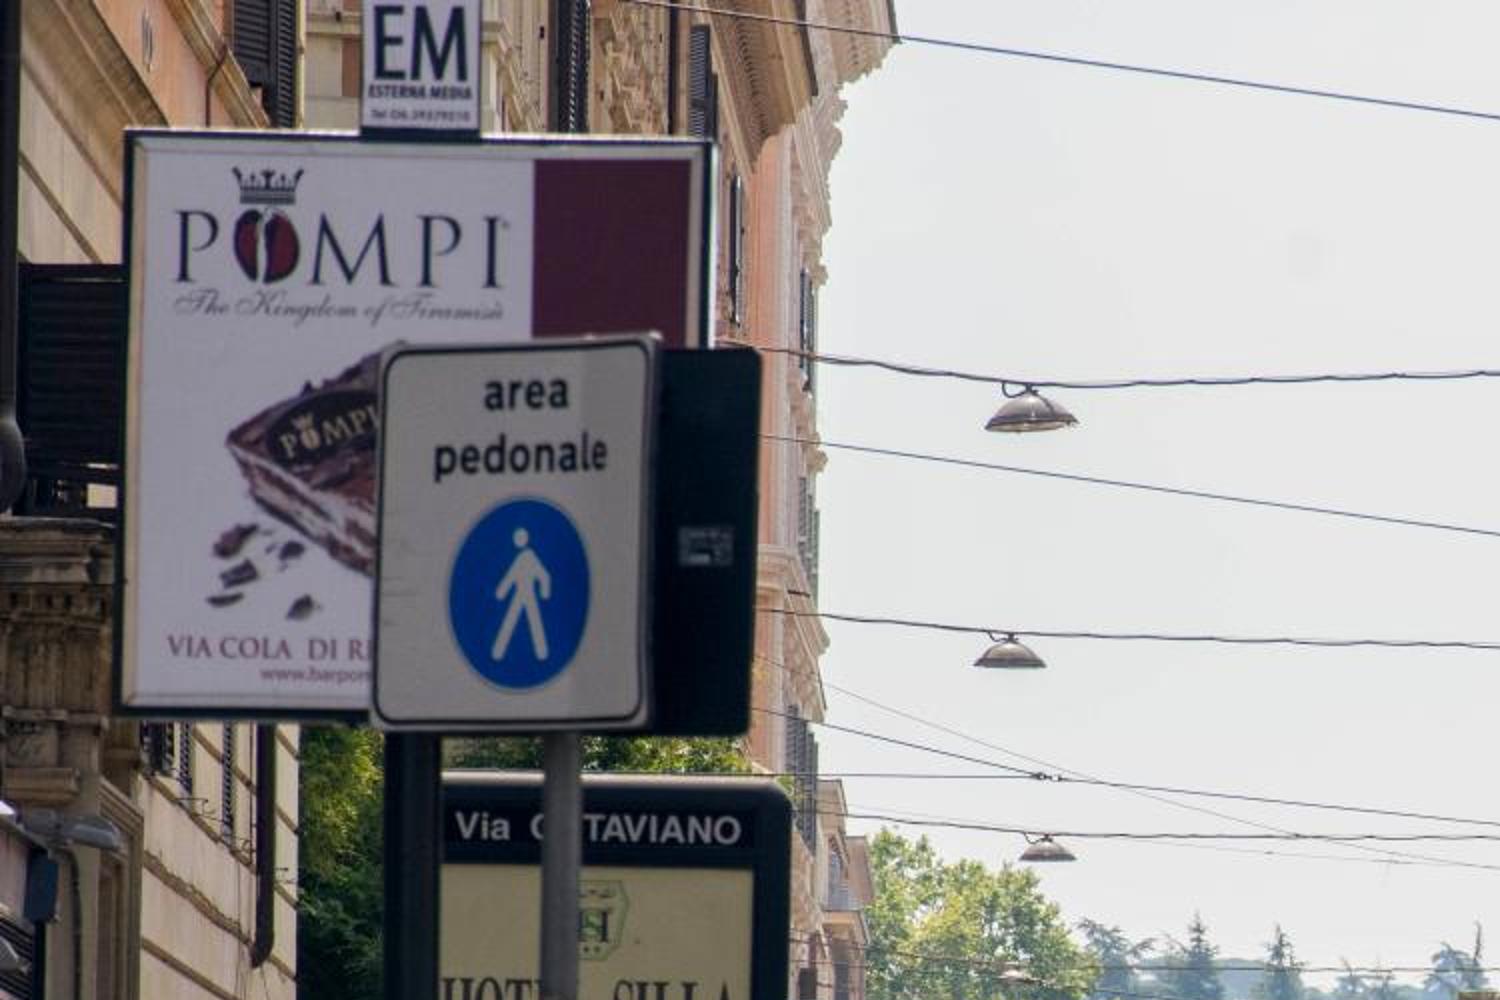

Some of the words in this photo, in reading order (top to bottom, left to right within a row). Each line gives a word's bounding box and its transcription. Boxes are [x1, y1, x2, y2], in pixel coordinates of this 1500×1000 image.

[374, 6, 468, 81] EM
[369, 84, 426, 99] ESTERNA
[429, 85, 473, 99] MEDIA
[174, 208, 505, 289] POMPI
[173, 288, 230, 317] The
[235, 290, 358, 328] Kingdom
[364, 295, 389, 327] of
[483, 378, 569, 411] area
[433, 429, 608, 483] pedonale
[167, 634, 213, 659] VIA
[219, 635, 293, 660] COLA
[307, 638, 338, 661] DI
[455, 811, 511, 841] Via
